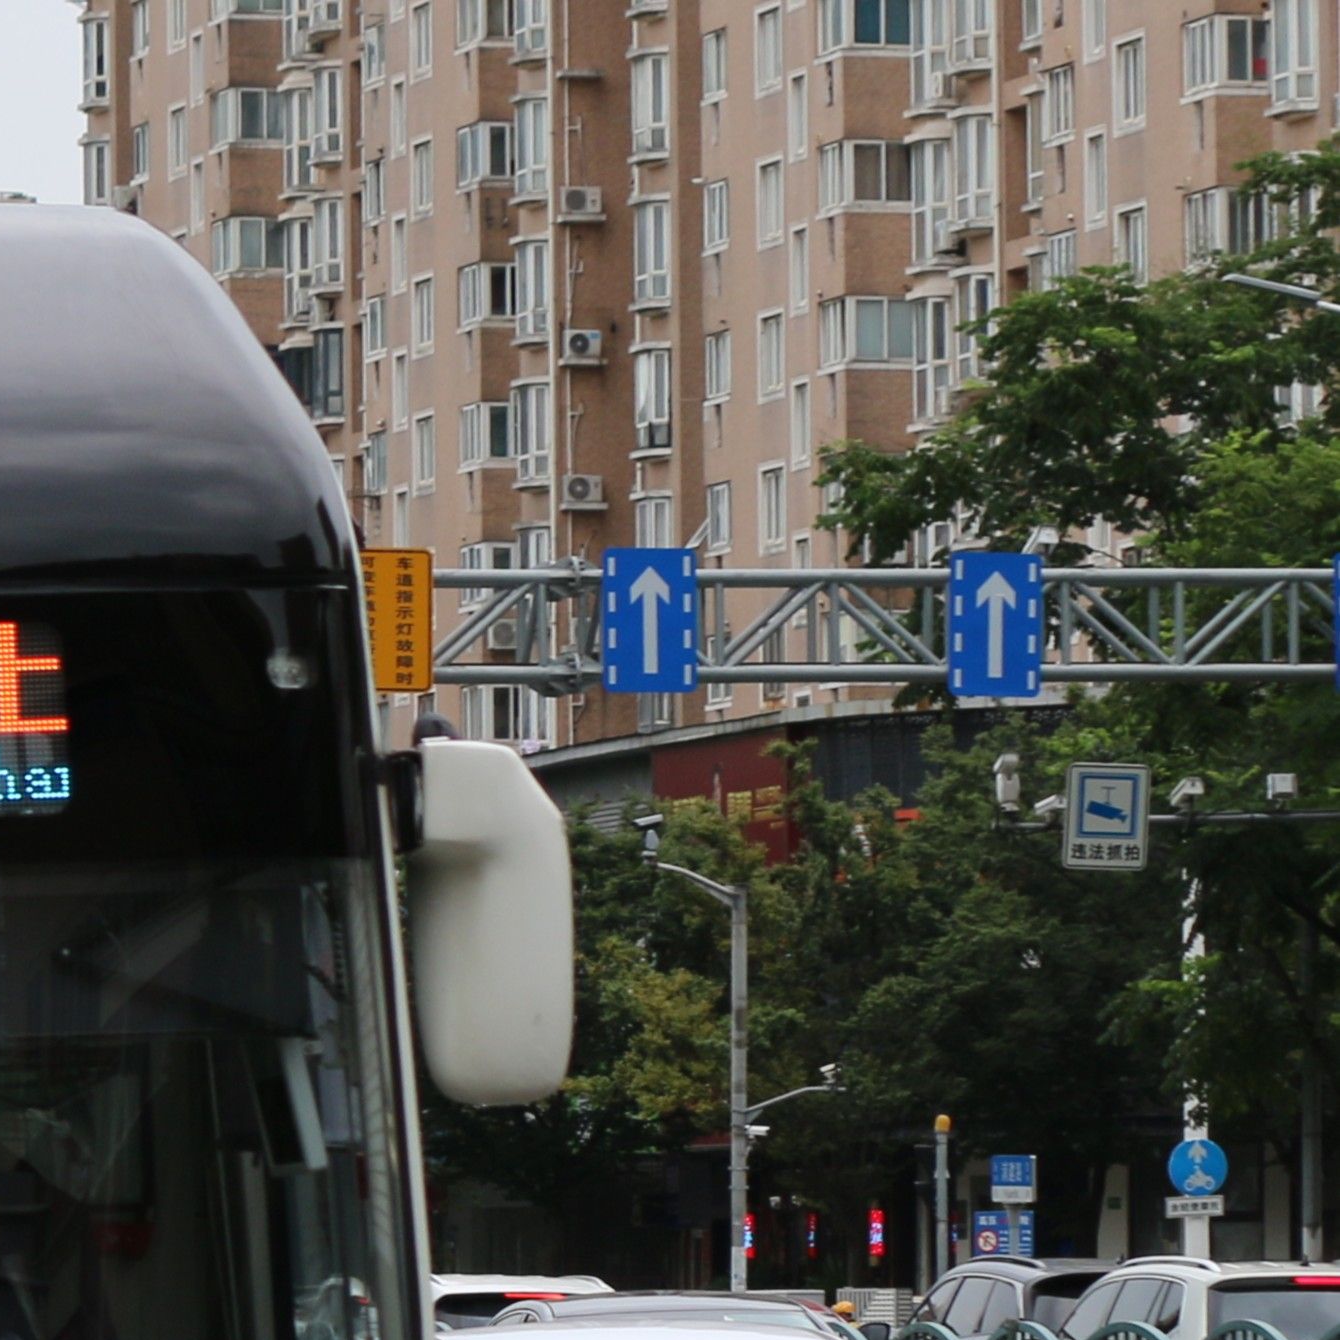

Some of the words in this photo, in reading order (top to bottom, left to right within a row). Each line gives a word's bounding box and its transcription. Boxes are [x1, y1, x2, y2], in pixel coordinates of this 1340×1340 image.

[395, 557, 414, 685] 车道指示灯故障时
[1070, 844, 1140, 860] 违法抓拍
